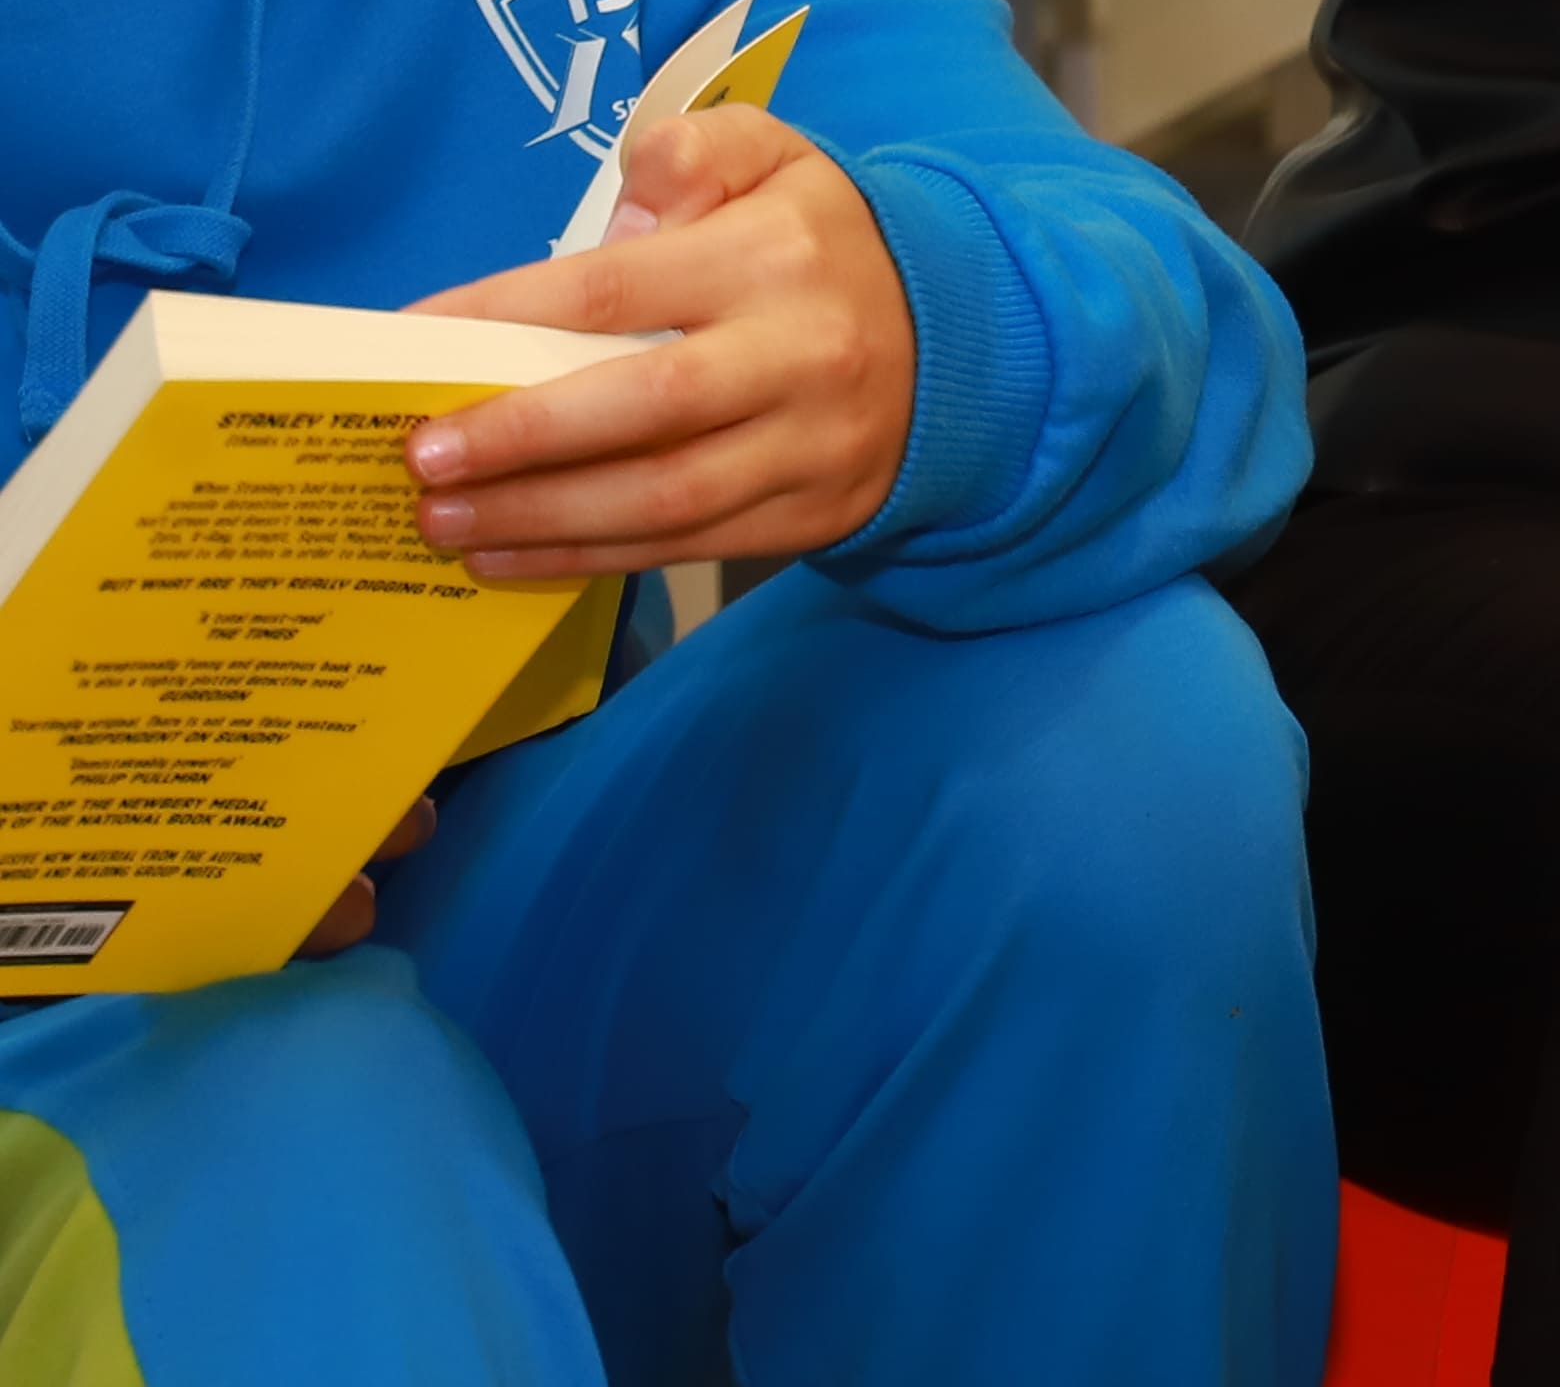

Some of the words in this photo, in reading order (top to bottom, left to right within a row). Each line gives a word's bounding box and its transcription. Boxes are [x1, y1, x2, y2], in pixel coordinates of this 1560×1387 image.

[218, 412, 323, 429] STANLEY
[329, 413, 430, 429] YELNATS
[98, 579, 135, 593] BUT
[141, 578, 193, 592] WHAT
[200, 578, 234, 591] ARE
[240, 578, 283, 590] THEY
[288, 578, 350, 591] REALLY
[354, 579, 426, 595] DIGGING
[430, 585, 478, 600] FOR?
[213, 732, 291, 744] SUNDAY
[70, 773, 129, 786] PHILIP
[130, 773, 214, 785] PULLMAN
[51, 798, 77, 811] OF
[82, 798, 114, 810] THE
[118, 797, 206, 810] NEWBERY
[209, 798, 268, 812] MEDAL
[11, 815, 36, 829] OF
[40, 815, 73, 827] THE
[77, 814, 161, 827] NATIONAL
[167, 814, 214, 826] BOOK
[220, 815, 287, 829] AWARD
